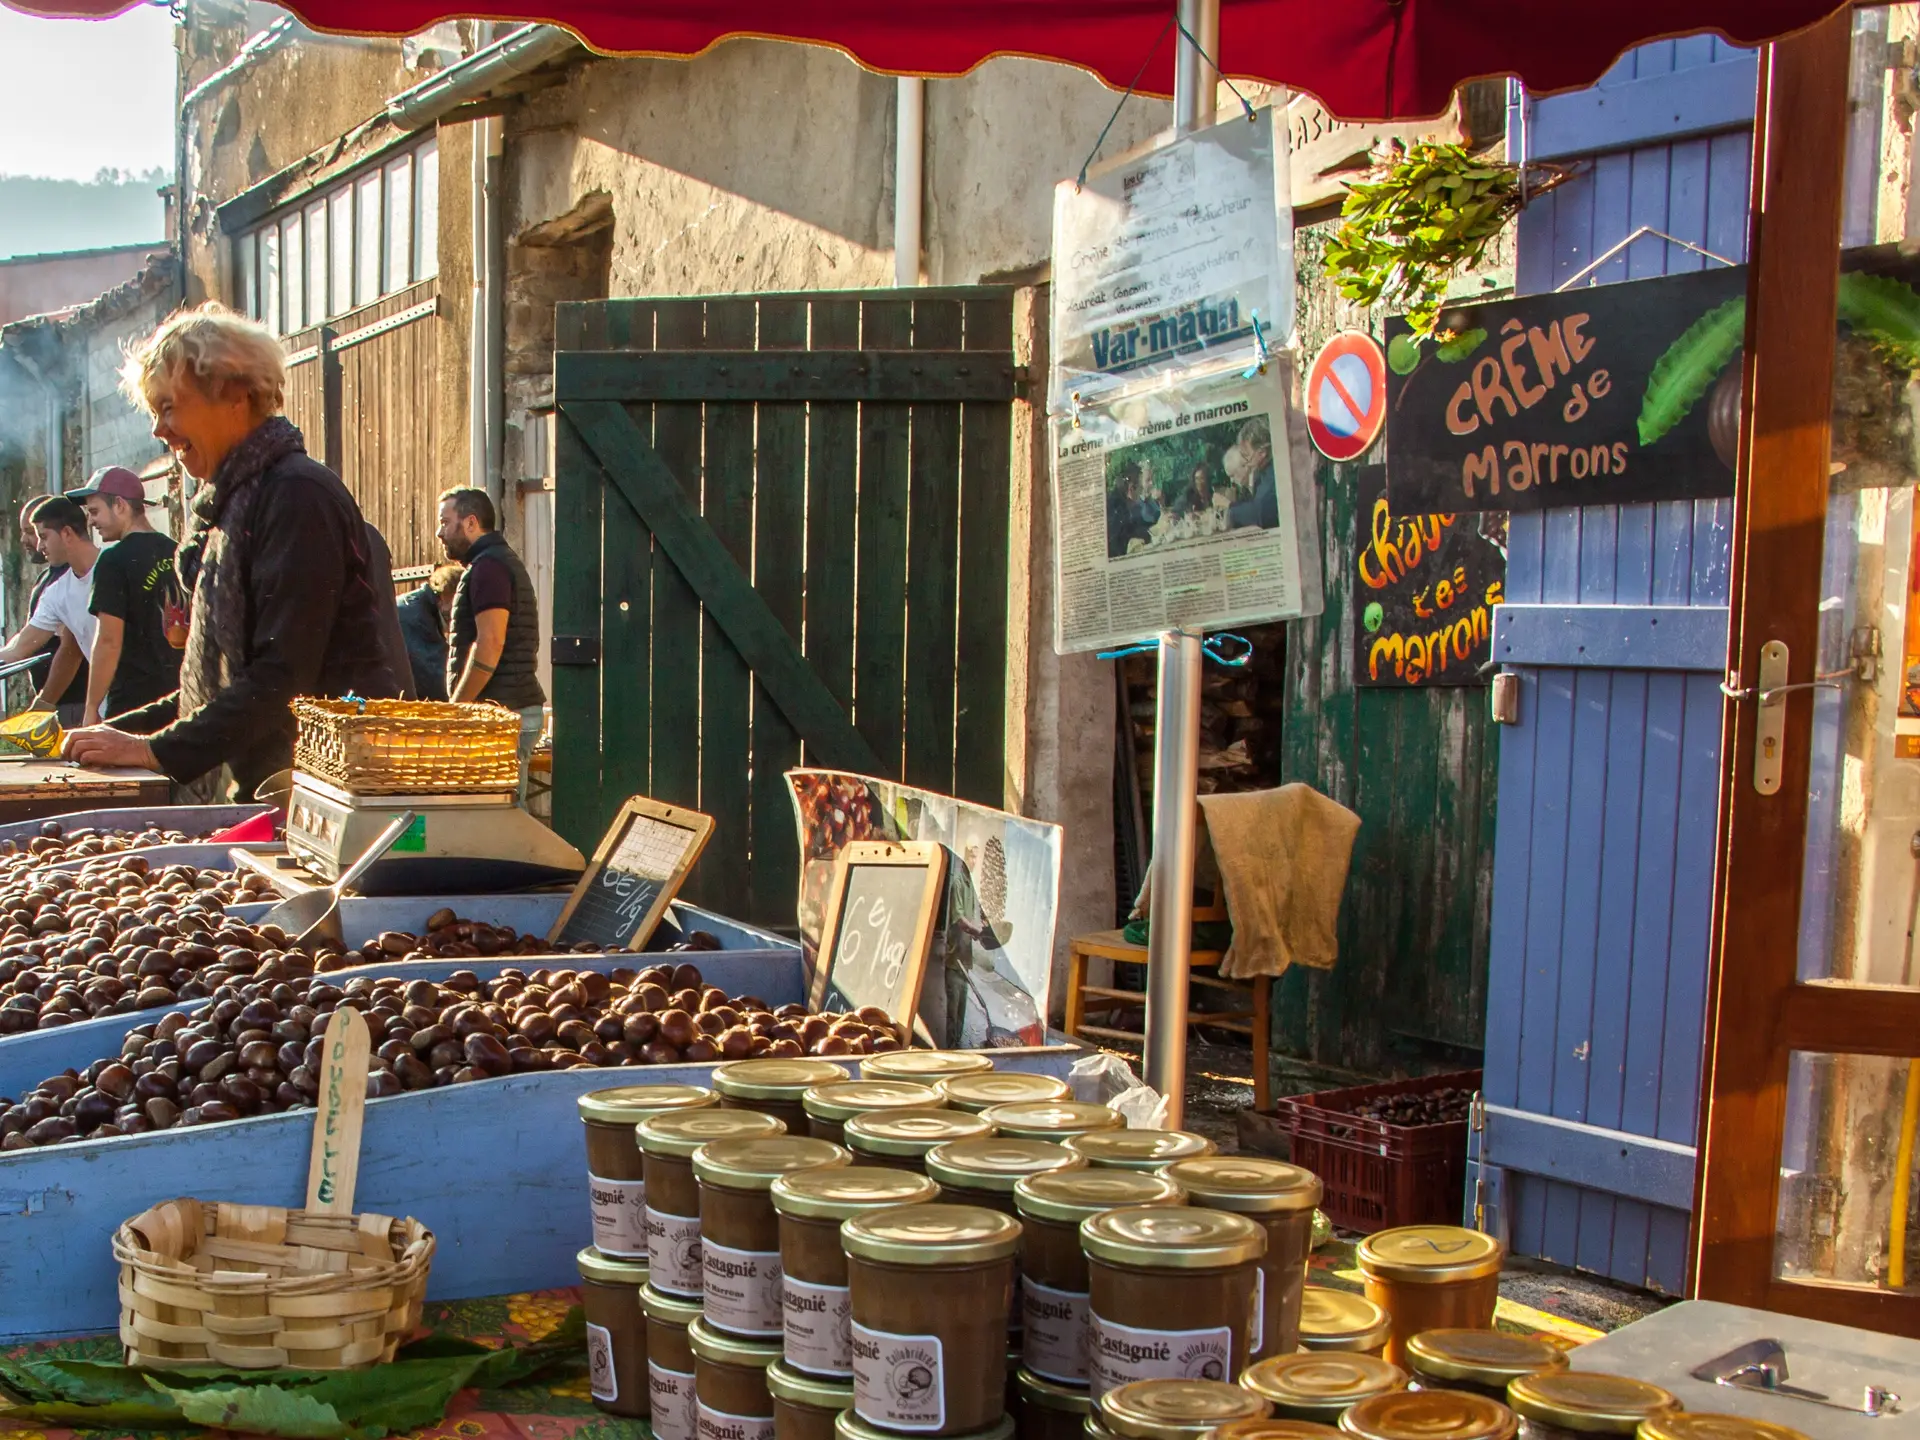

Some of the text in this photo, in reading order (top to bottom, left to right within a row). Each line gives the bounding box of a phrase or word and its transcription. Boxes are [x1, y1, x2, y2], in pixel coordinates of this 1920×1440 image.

[1445, 312, 1597, 436] CRÊME
[1563, 368, 1612, 423] de
[1071, 436, 1104, 454] crème
[1107, 430, 1121, 444] de
[1137, 419, 1173, 438] crème
[1176, 412, 1191, 427] de
[1194, 399, 1249, 423] marrons
[703, 1250, 757, 1279] Castagnié
